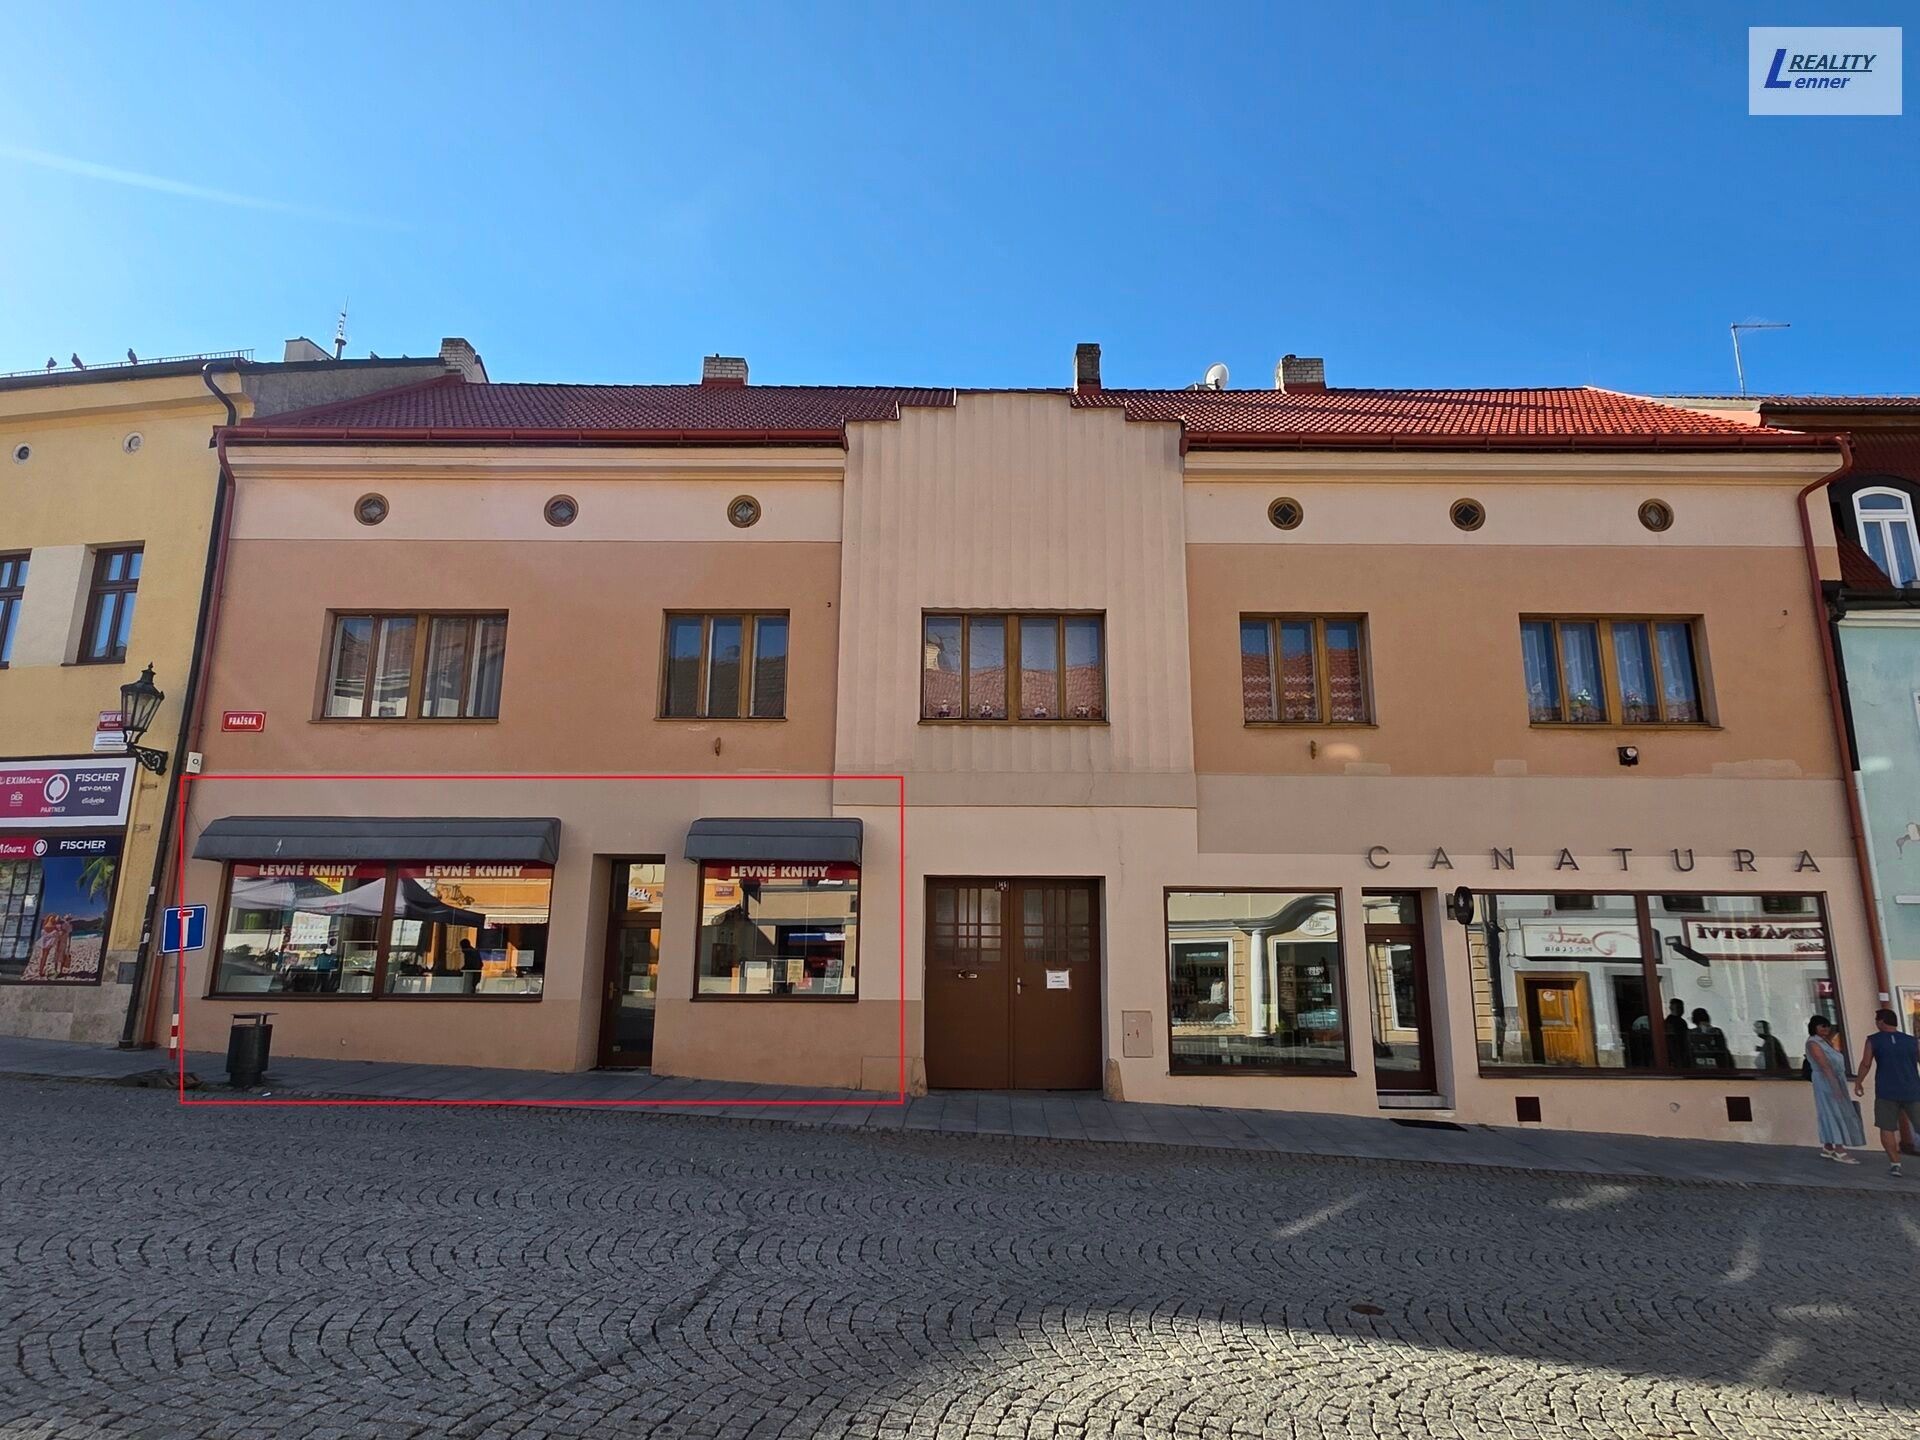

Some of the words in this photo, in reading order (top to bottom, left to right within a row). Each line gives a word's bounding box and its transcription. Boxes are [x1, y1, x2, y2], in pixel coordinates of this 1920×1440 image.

[228, 715, 257, 726] PRAŽSKÁ
[75, 773, 120, 782] FISCHER
[60, 840, 106, 850] FISCHER
[1366, 845, 1821, 874] CANATURA
[259, 862, 305, 876] LEVNÉ
[309, 864, 357, 876] KNIHY
[425, 862, 471, 877] LEVNÉ
[475, 865, 523, 877] KNIHY
[730, 863, 776, 878] LEVNÉ
[780, 866, 829, 878] KNIHY
